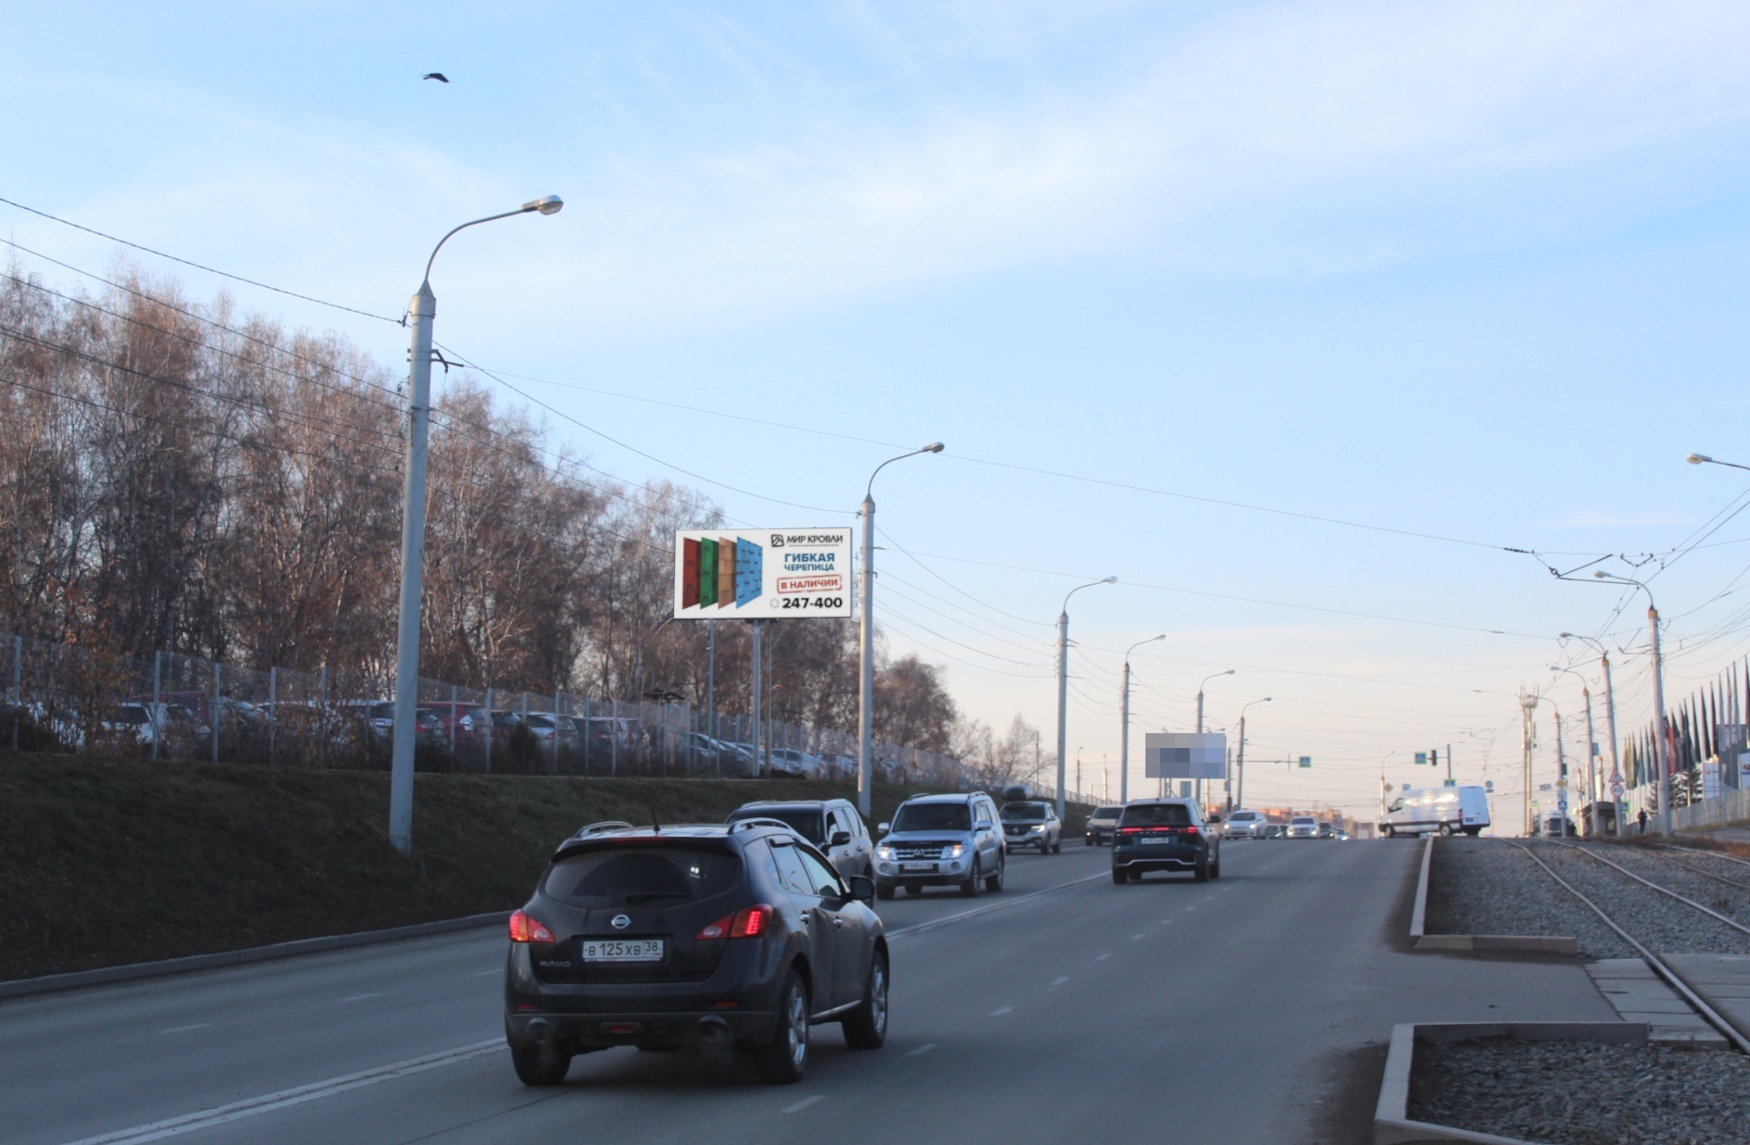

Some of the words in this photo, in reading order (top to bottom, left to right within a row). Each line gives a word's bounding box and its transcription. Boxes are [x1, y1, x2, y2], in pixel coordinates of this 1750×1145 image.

[786, 535, 806, 543] МИР
[807, 534, 843, 543] КРОВЛИ
[784, 553, 835, 562] ГИБКАЯ
[790, 579, 838, 588] НАЛИЧИИ
[782, 597, 843, 609] 247-400
[645, 941, 658, 952] 38
